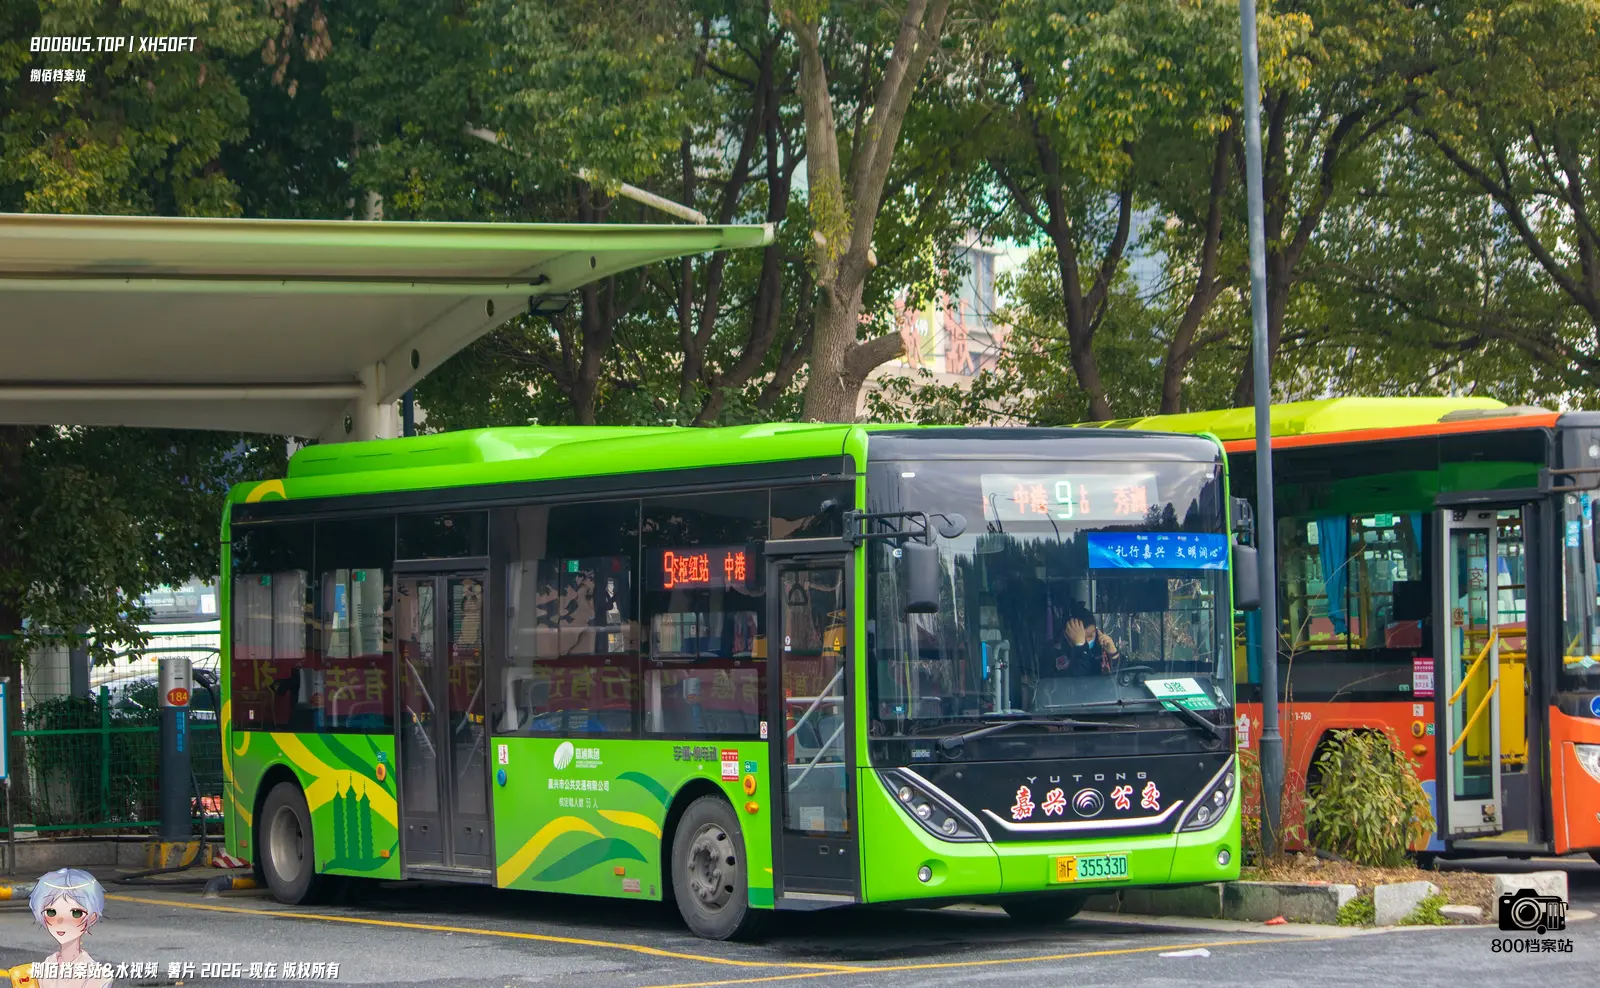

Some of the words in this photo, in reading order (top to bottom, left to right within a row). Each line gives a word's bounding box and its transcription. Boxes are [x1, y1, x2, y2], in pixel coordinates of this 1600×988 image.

[1055, 480, 1073, 519] 9
[724, 551, 746, 581] 中港
[1163, 681, 1186, 693] 9路
[169, 692, 188, 702] 184
[548, 778, 610, 792] 嘉兴市公共交通有限公司
[1027, 772, 1147, 784] YUTONG
[1011, 785, 1067, 820] 嘉兴
[1110, 781, 1160, 811] 公交
[1080, 857, 1127, 877] 35533D
